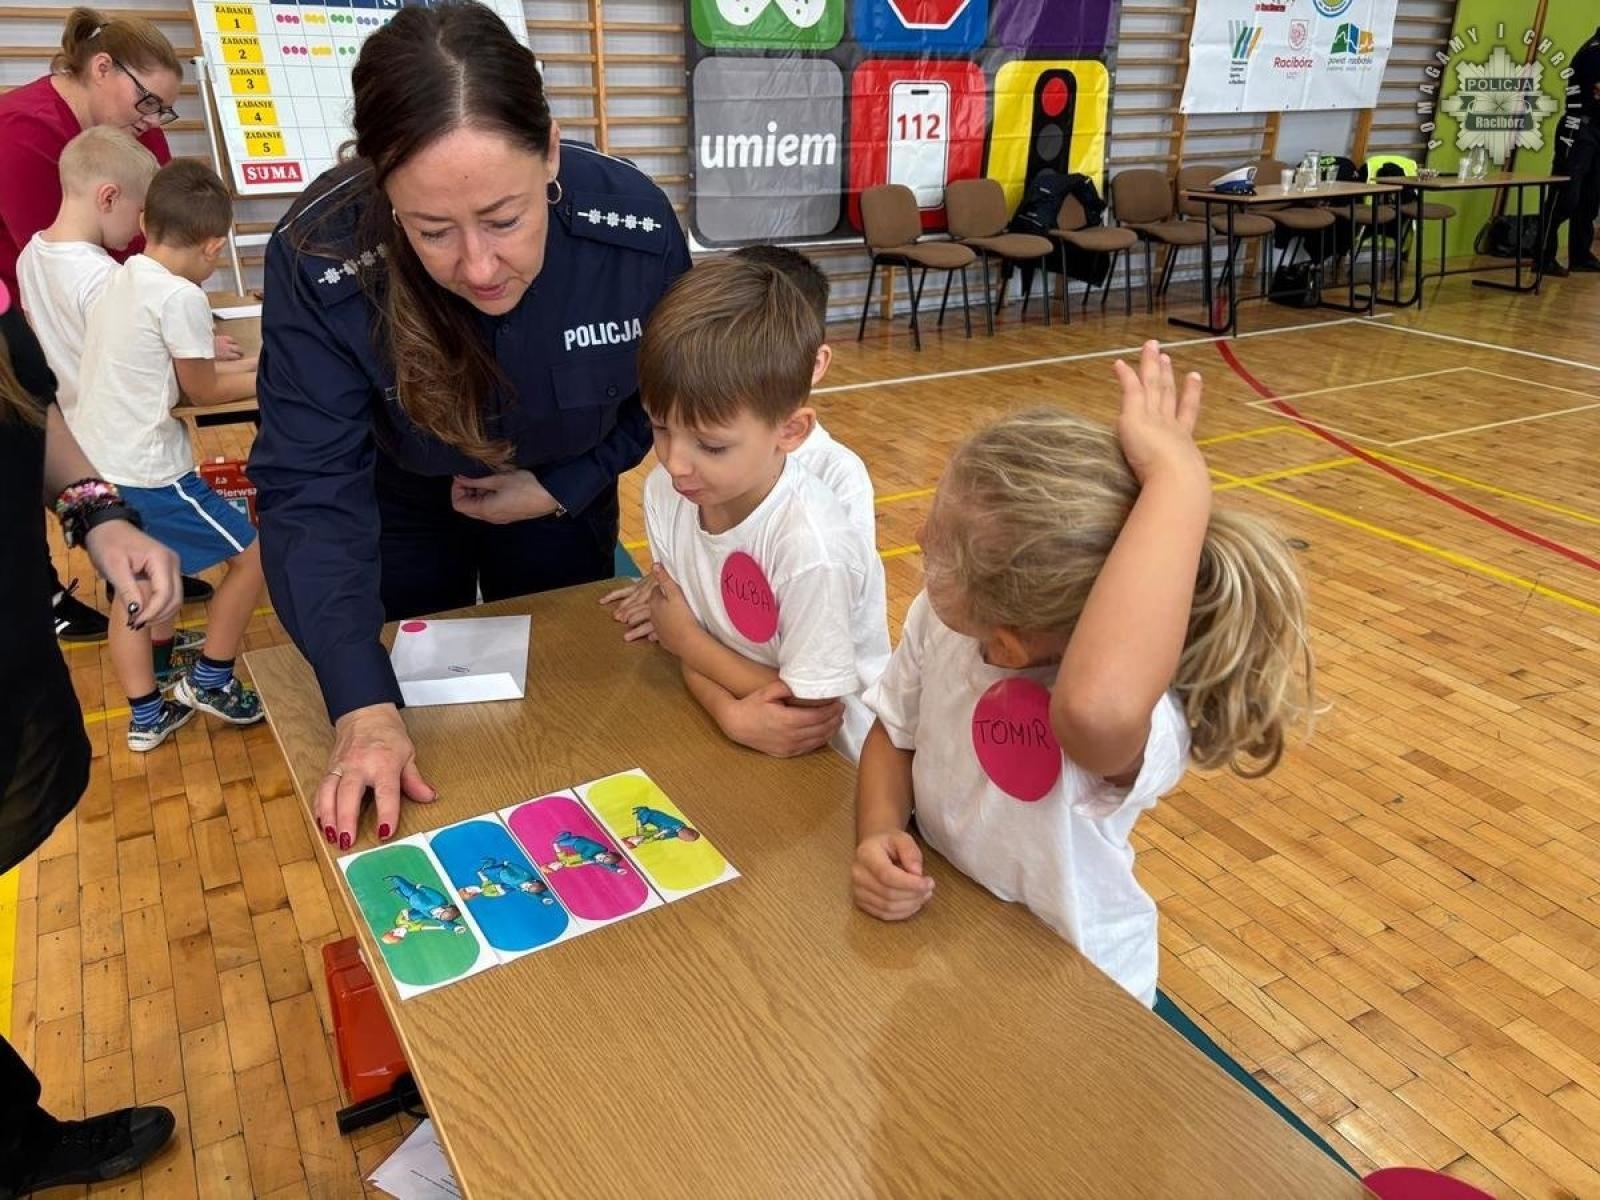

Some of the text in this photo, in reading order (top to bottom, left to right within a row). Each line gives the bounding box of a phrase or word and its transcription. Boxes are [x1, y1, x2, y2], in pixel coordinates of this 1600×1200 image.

[215, 6, 253, 15] ZADANIE
[234, 18, 240, 29] 1
[221, 37, 258, 45] ZADANIE
[239, 49, 247, 60] 2
[229, 68, 266, 76] ZADANIE
[246, 79, 255, 89] 3
[254, 112, 262, 122] 4
[896, 114, 941, 140] 112
[244, 131, 281, 139] ZADANIE
[263, 142, 271, 153] 5
[700, 121, 836, 168] umiem
[246, 166, 299, 181] SUMA
[563, 317, 643, 351] POLICJA
[724, 573, 771, 612] KUBA
[974, 717, 1051, 750] TOMIR
